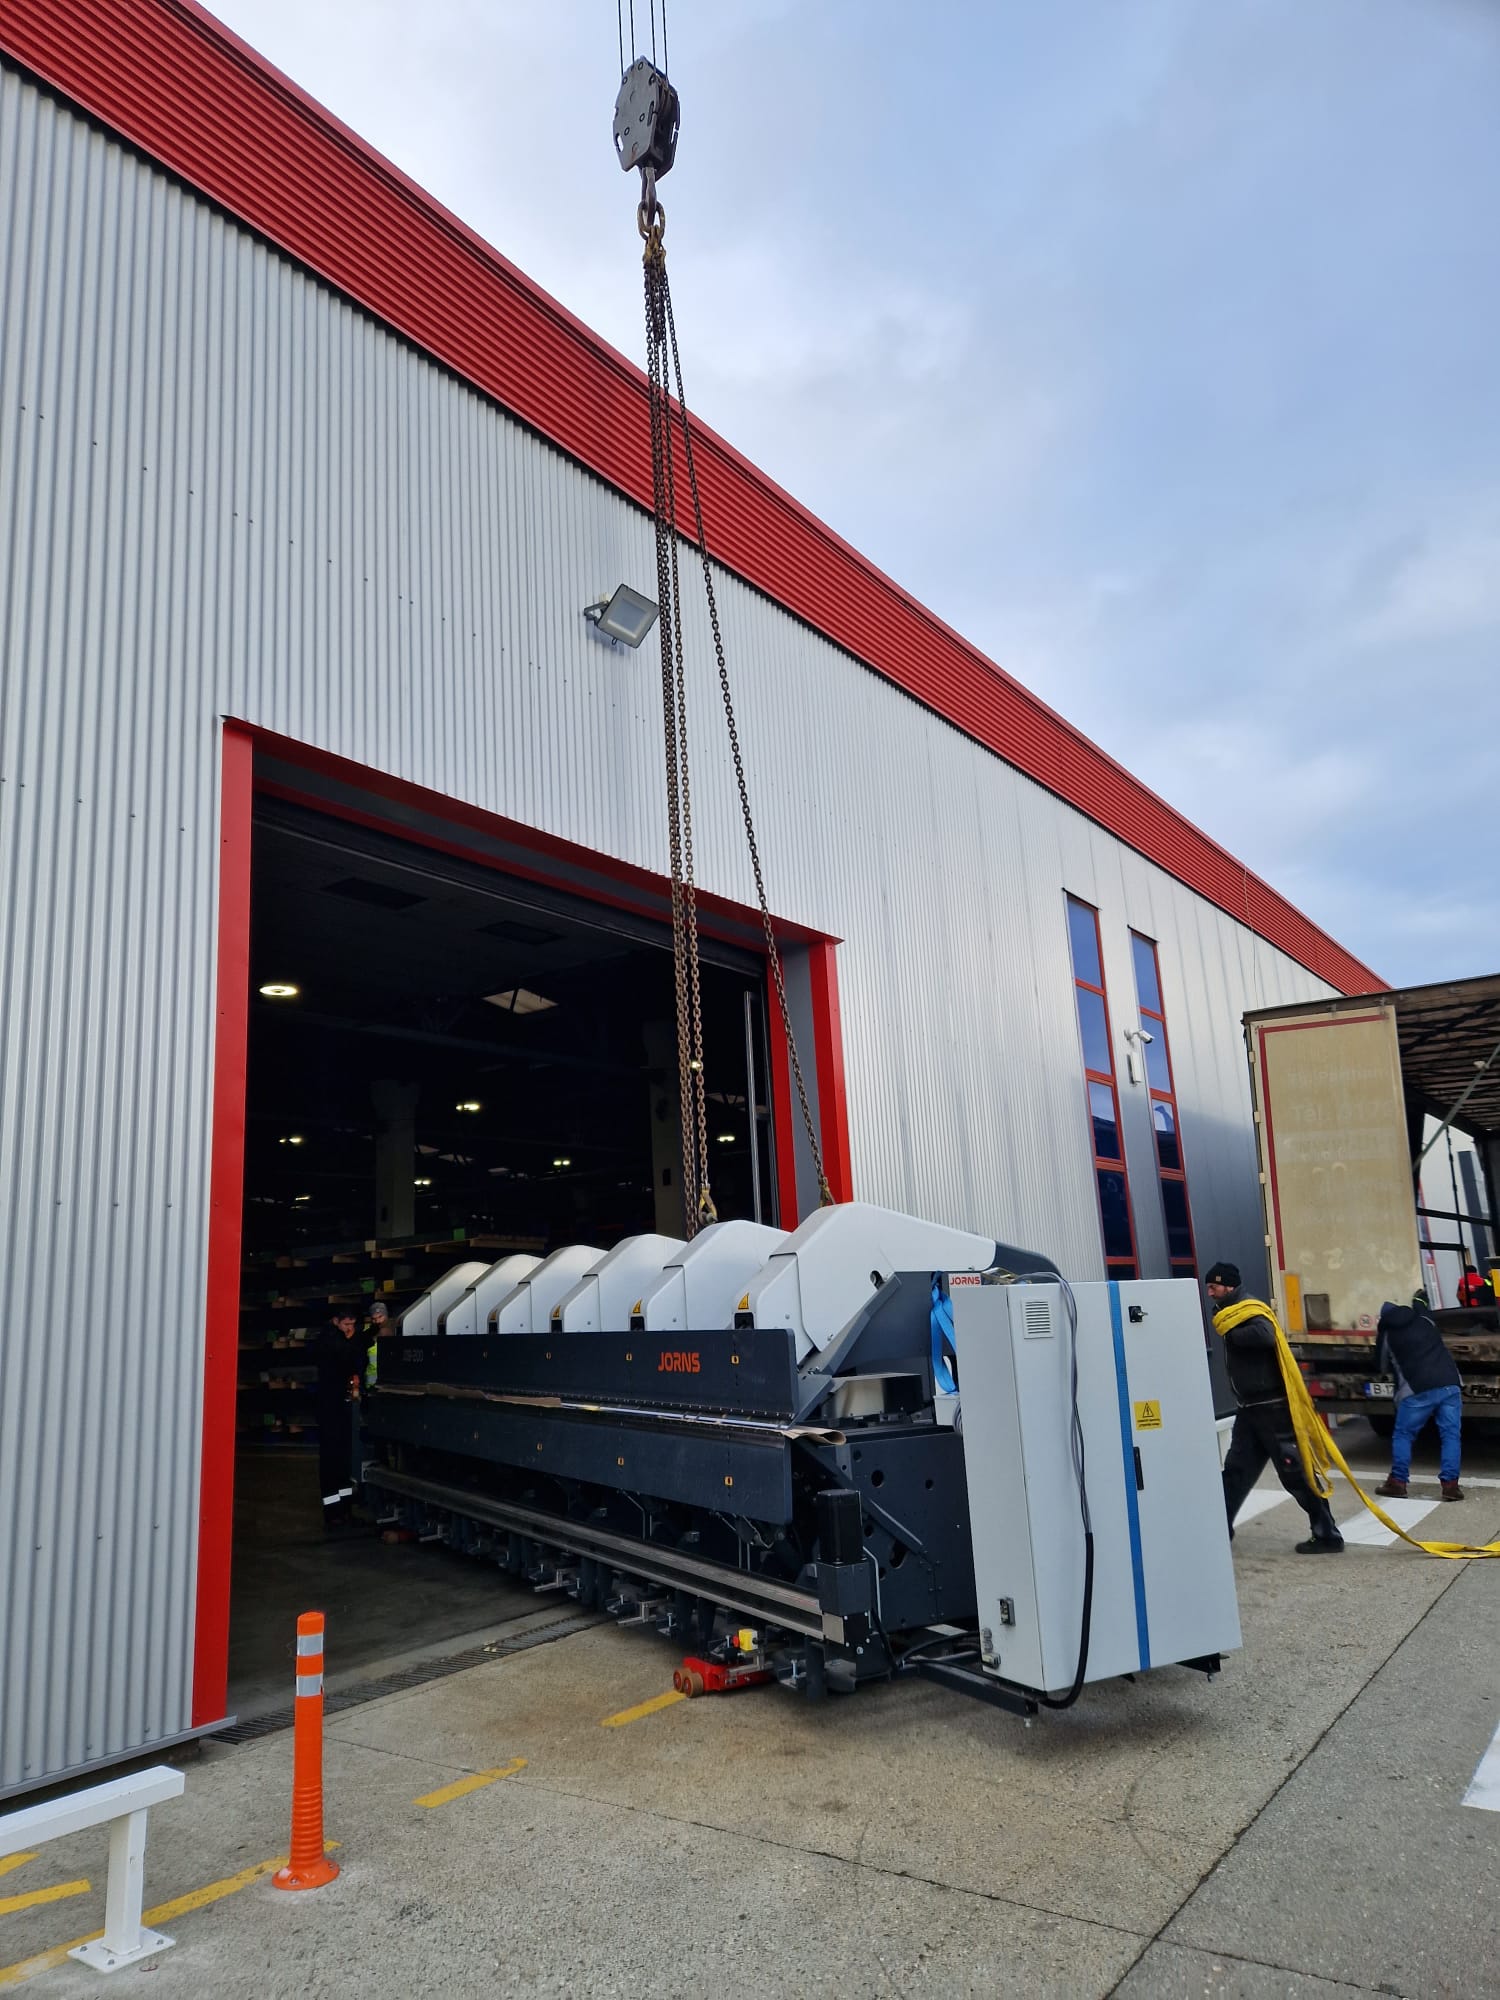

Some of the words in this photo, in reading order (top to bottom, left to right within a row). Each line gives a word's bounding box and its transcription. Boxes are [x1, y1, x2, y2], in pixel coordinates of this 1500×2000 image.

[951, 1276, 981, 1285] JORNS
[658, 1351, 701, 1373] JORNS
[1373, 1383, 1381, 1395] B
